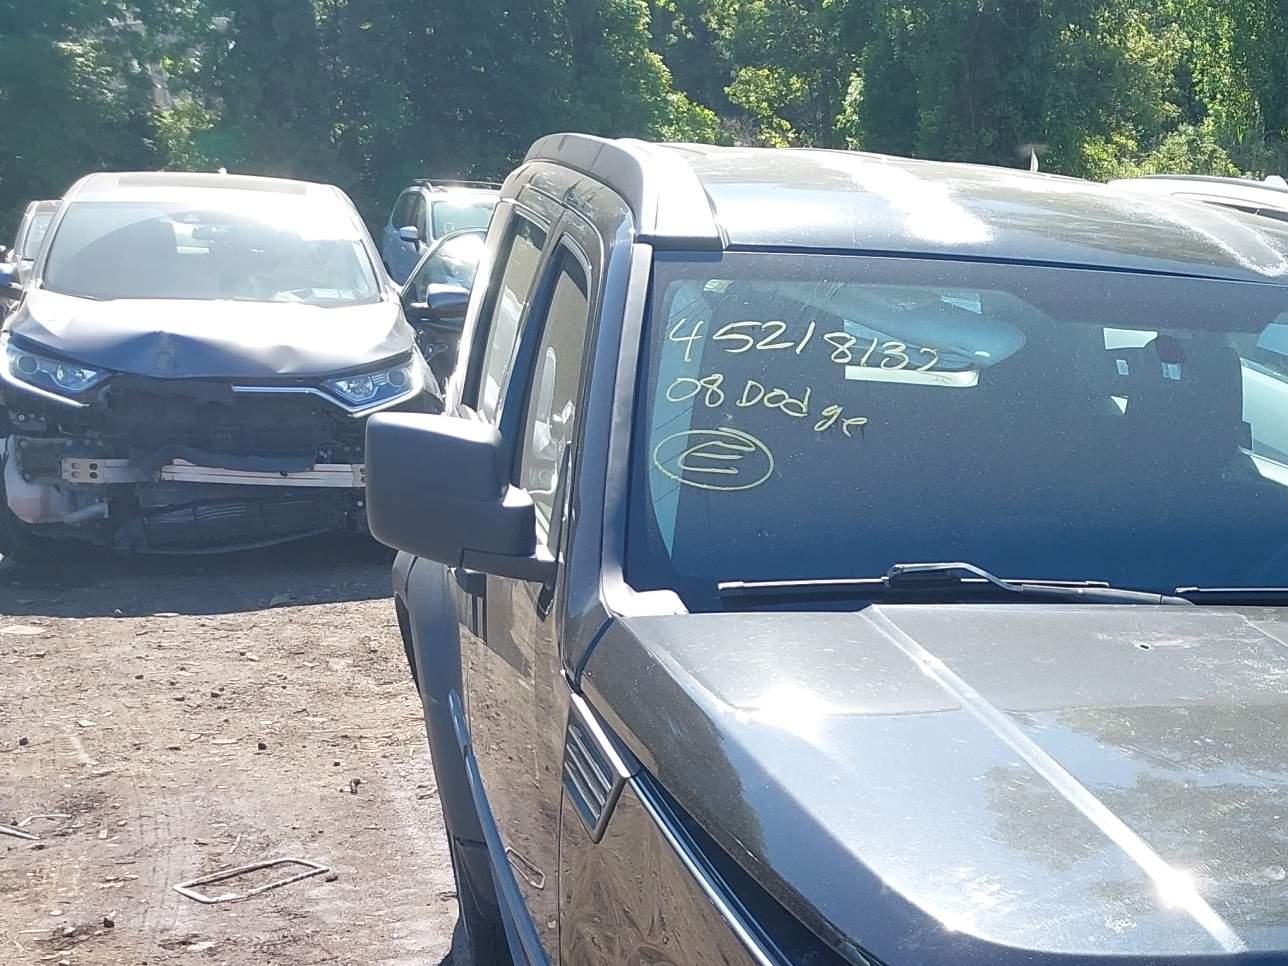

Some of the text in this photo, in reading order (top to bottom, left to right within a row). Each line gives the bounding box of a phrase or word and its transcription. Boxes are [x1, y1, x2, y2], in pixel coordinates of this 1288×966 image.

[668, 318, 939, 372] 45218132
[666, 373, 869, 437] 08 Dodge
